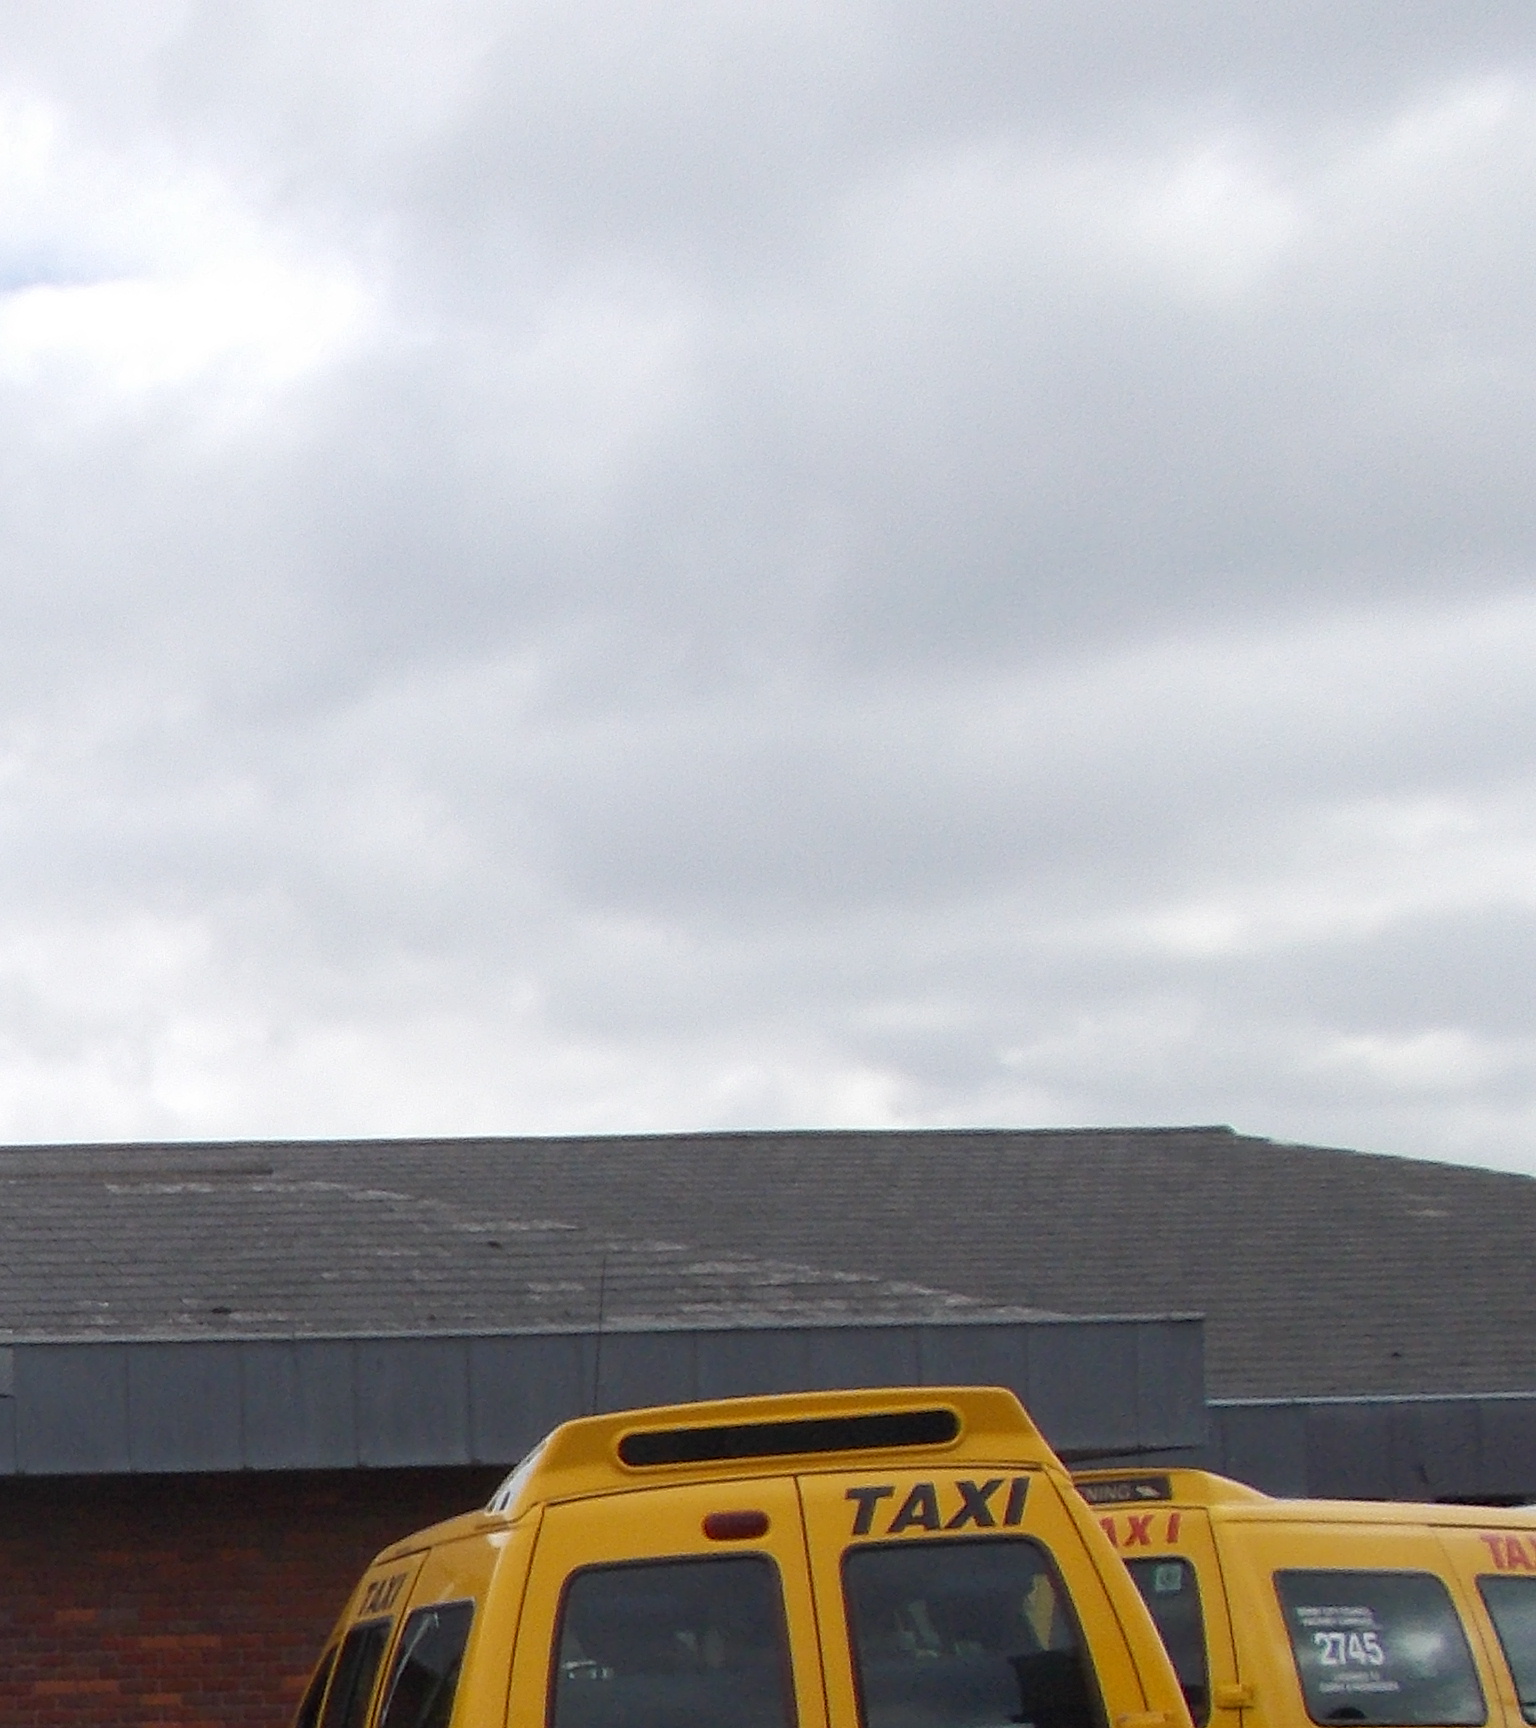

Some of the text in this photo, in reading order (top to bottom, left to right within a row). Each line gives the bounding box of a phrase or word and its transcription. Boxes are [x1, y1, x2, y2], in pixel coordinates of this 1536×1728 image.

[845, 1476, 1031, 1536] TAXI
[1480, 1533, 1536, 1571] TA
[1313, 1631, 1385, 1667] 2745
